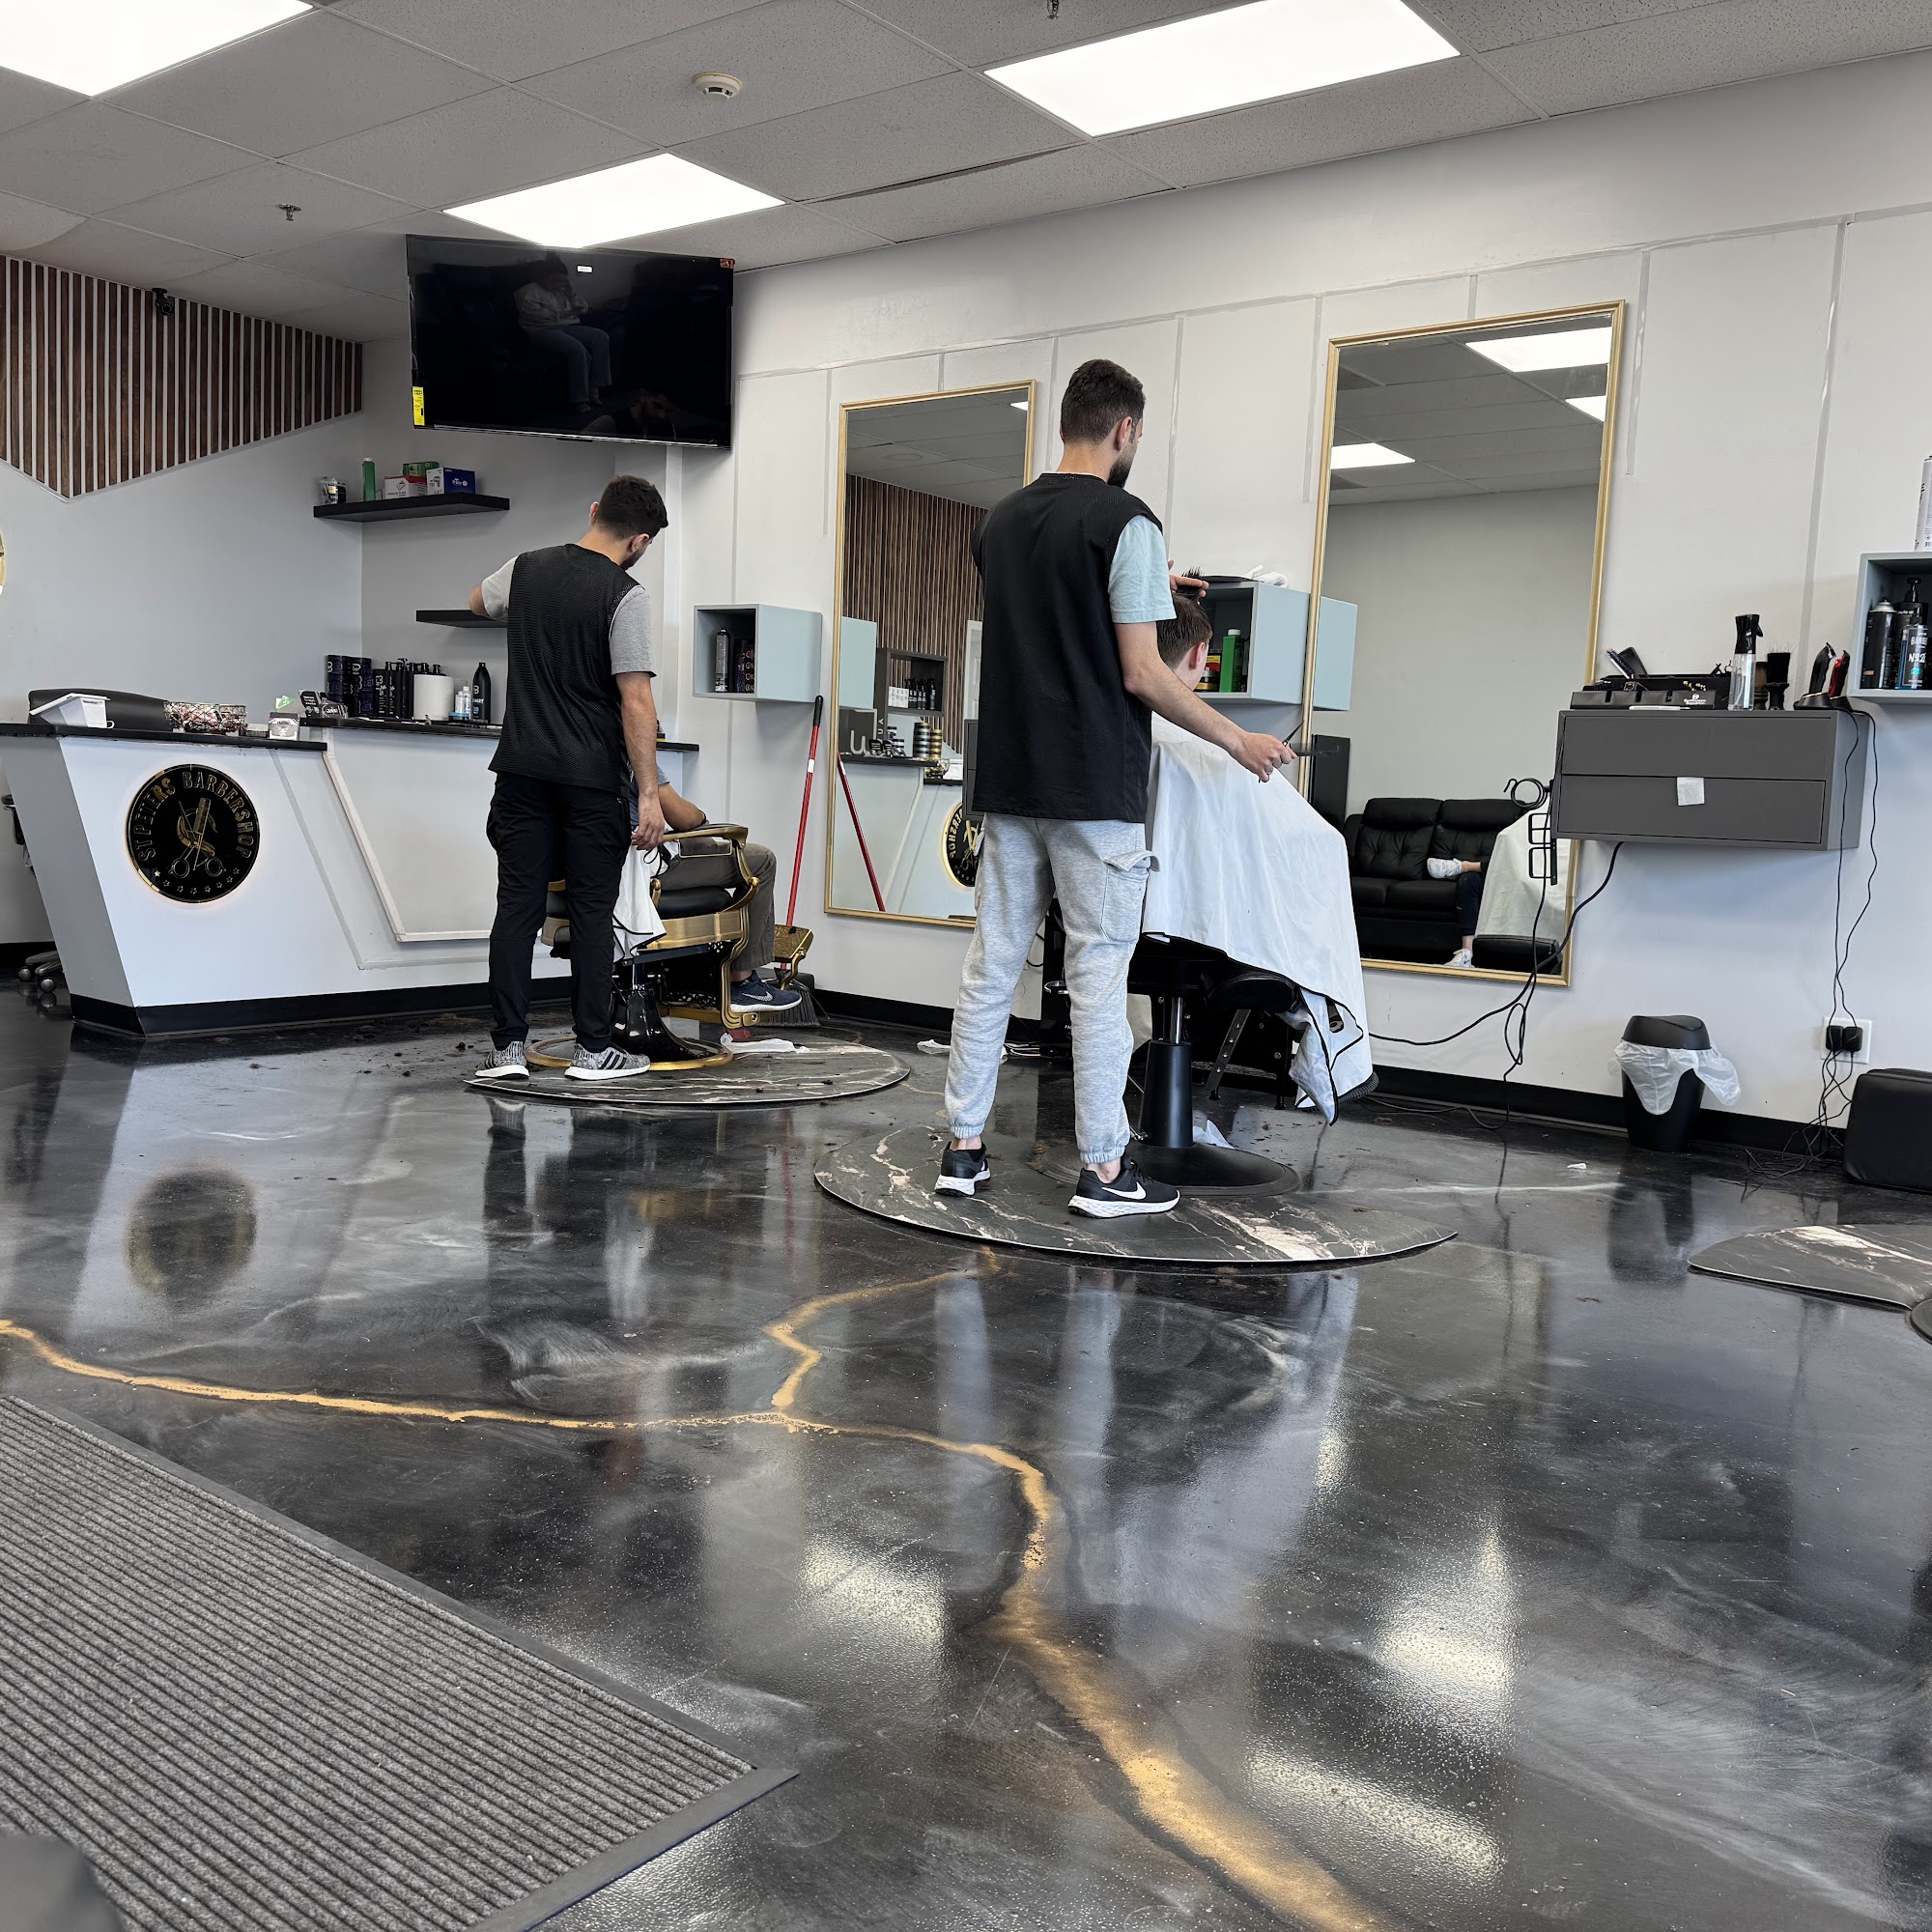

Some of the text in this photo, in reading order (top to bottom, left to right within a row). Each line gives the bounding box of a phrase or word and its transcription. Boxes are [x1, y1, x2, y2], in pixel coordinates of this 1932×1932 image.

[133, 771, 255, 862] ST PETERS BARBERSHOP
